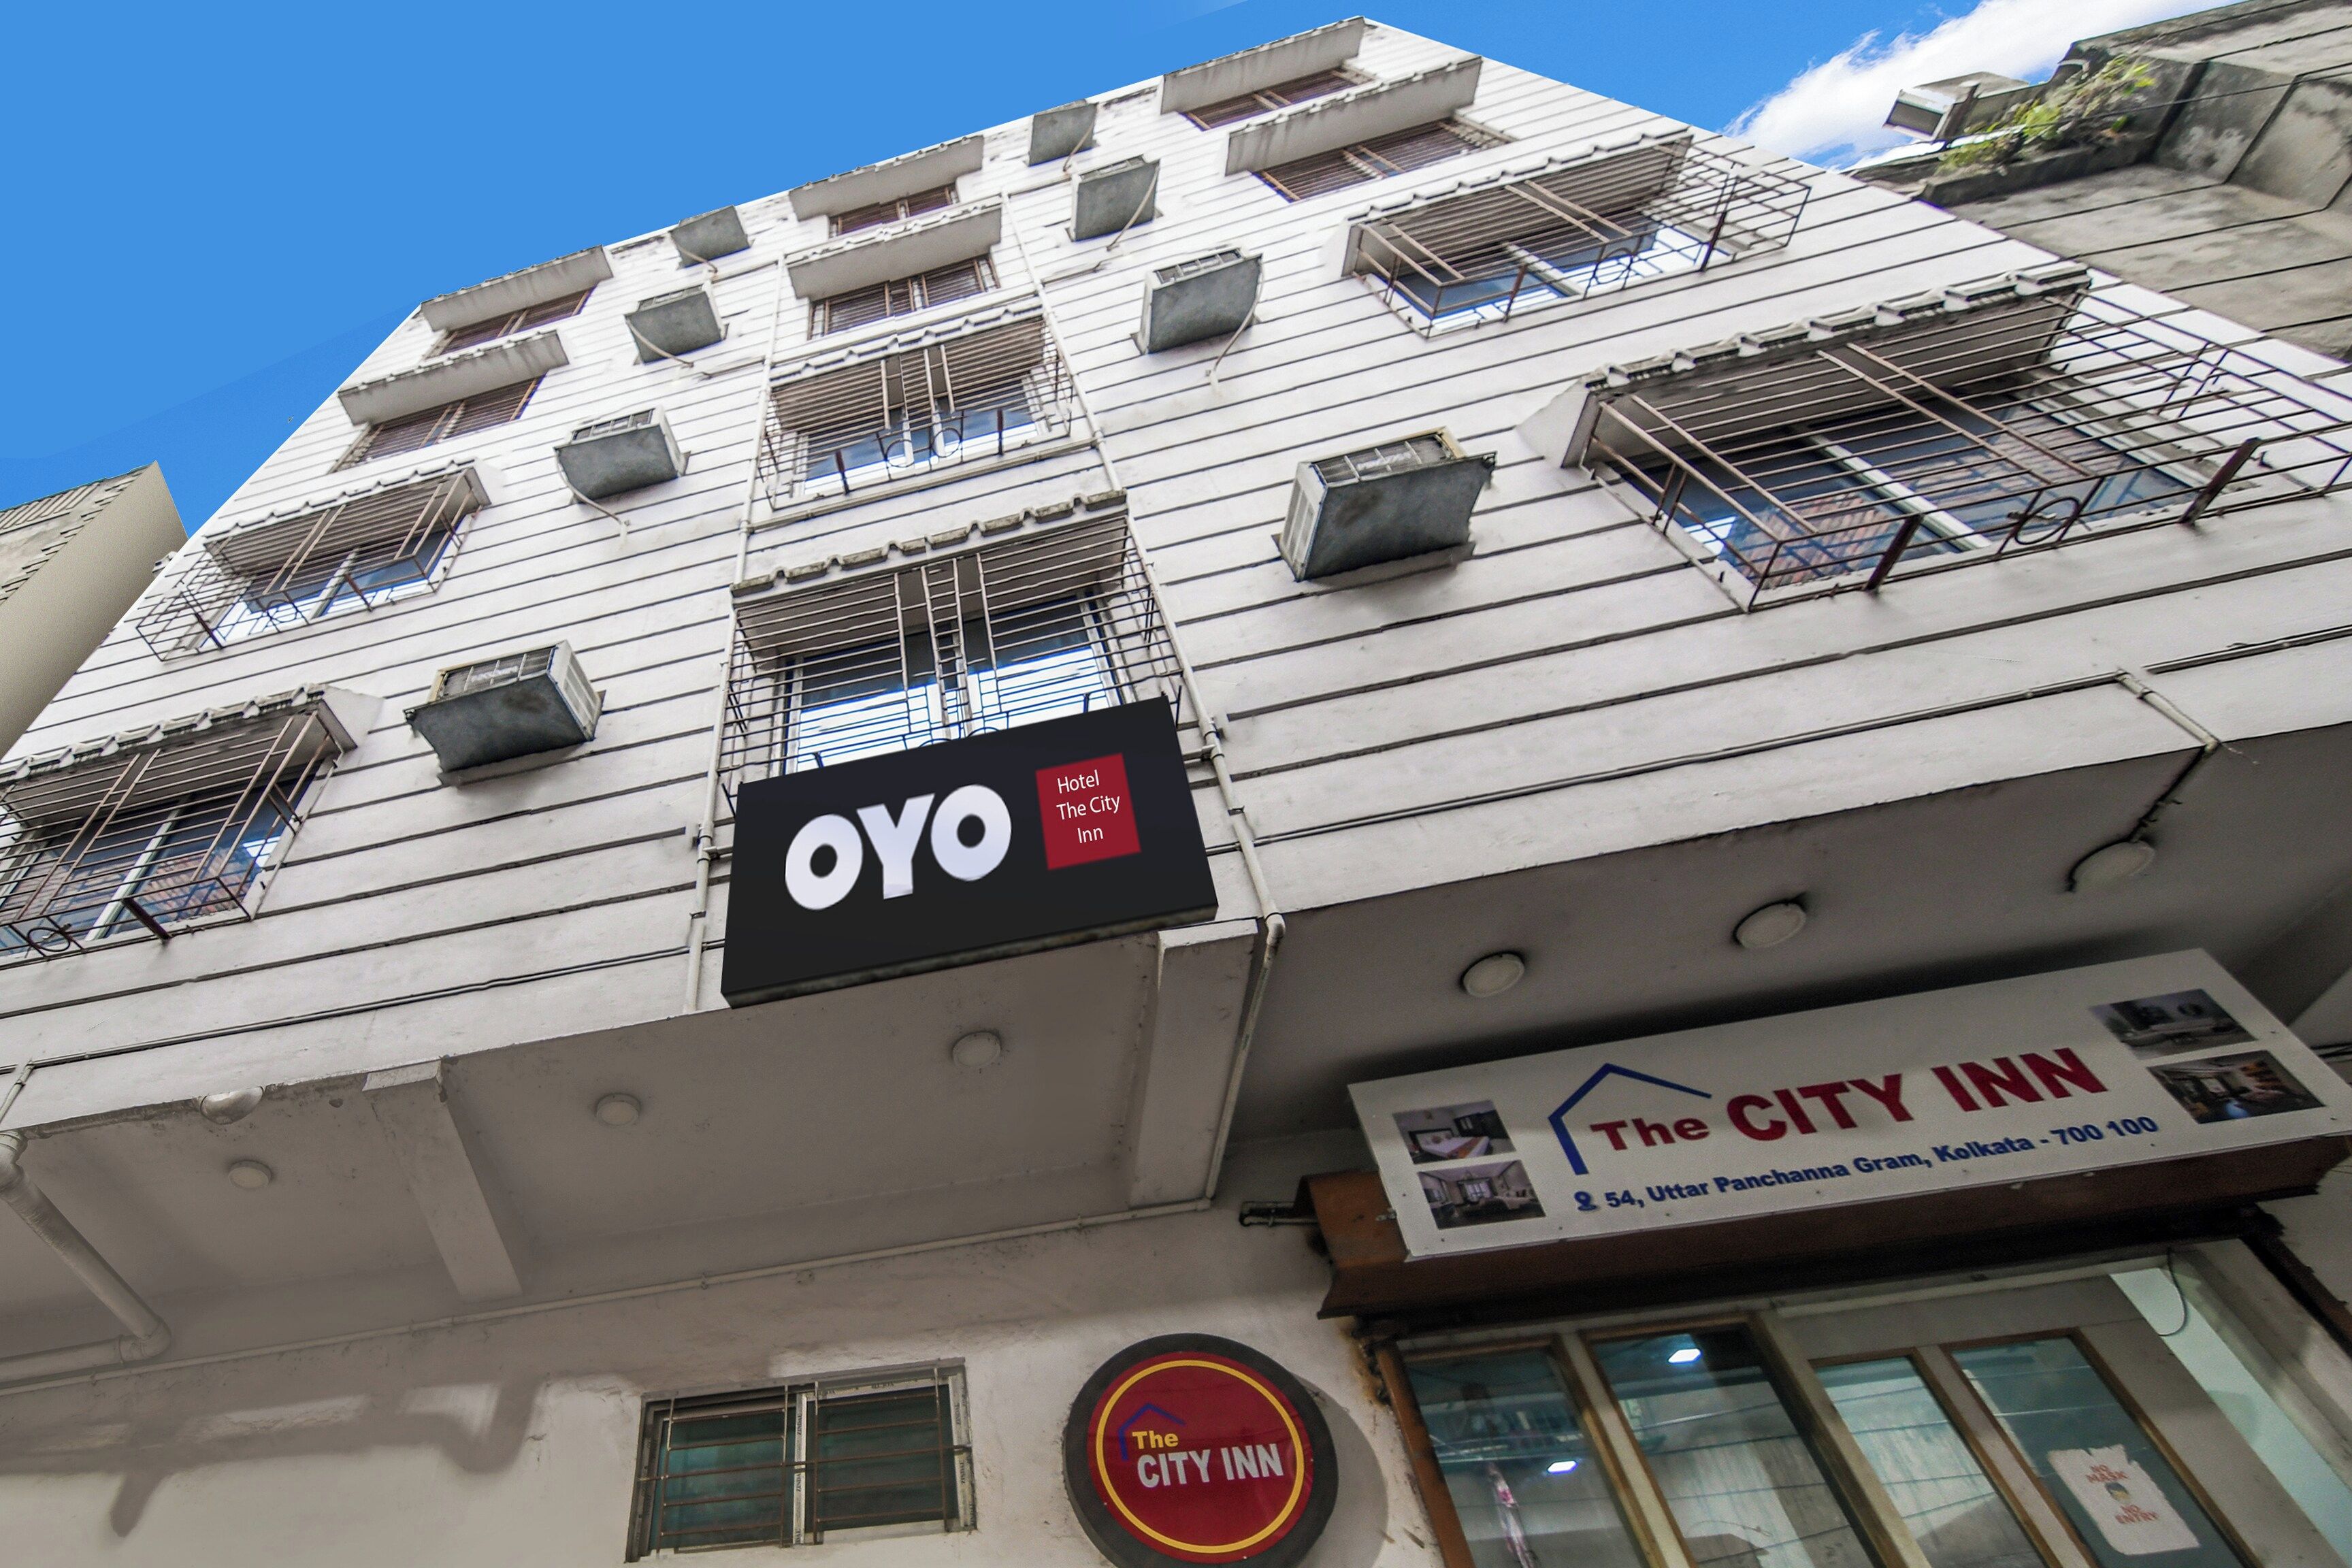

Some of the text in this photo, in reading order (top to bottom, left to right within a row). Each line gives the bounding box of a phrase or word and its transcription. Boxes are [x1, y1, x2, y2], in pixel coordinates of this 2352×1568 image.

[1057, 770, 1100, 794] Hotel
[1056, 794, 1121, 821] The City
[785, 784, 1011, 911] OYO
[1077, 827, 1104, 844] Inn
[1590, 1047, 2108, 1150] The CITY INN
[1605, 1190, 1645, 1208] 54,
[1647, 1181, 1710, 1202] Uttar
[1714, 1163, 1849, 1194] Panchanna
[1853, 1152, 1932, 1175] Gram,
[1933, 1136, 2035, 1164] Kolkata
[2051, 1125, 2103, 1147] 700
[2107, 1116, 2159, 1138] 100
[1132, 1431, 1179, 1450] The
[1137, 1443, 1284, 1488] CITY INN
